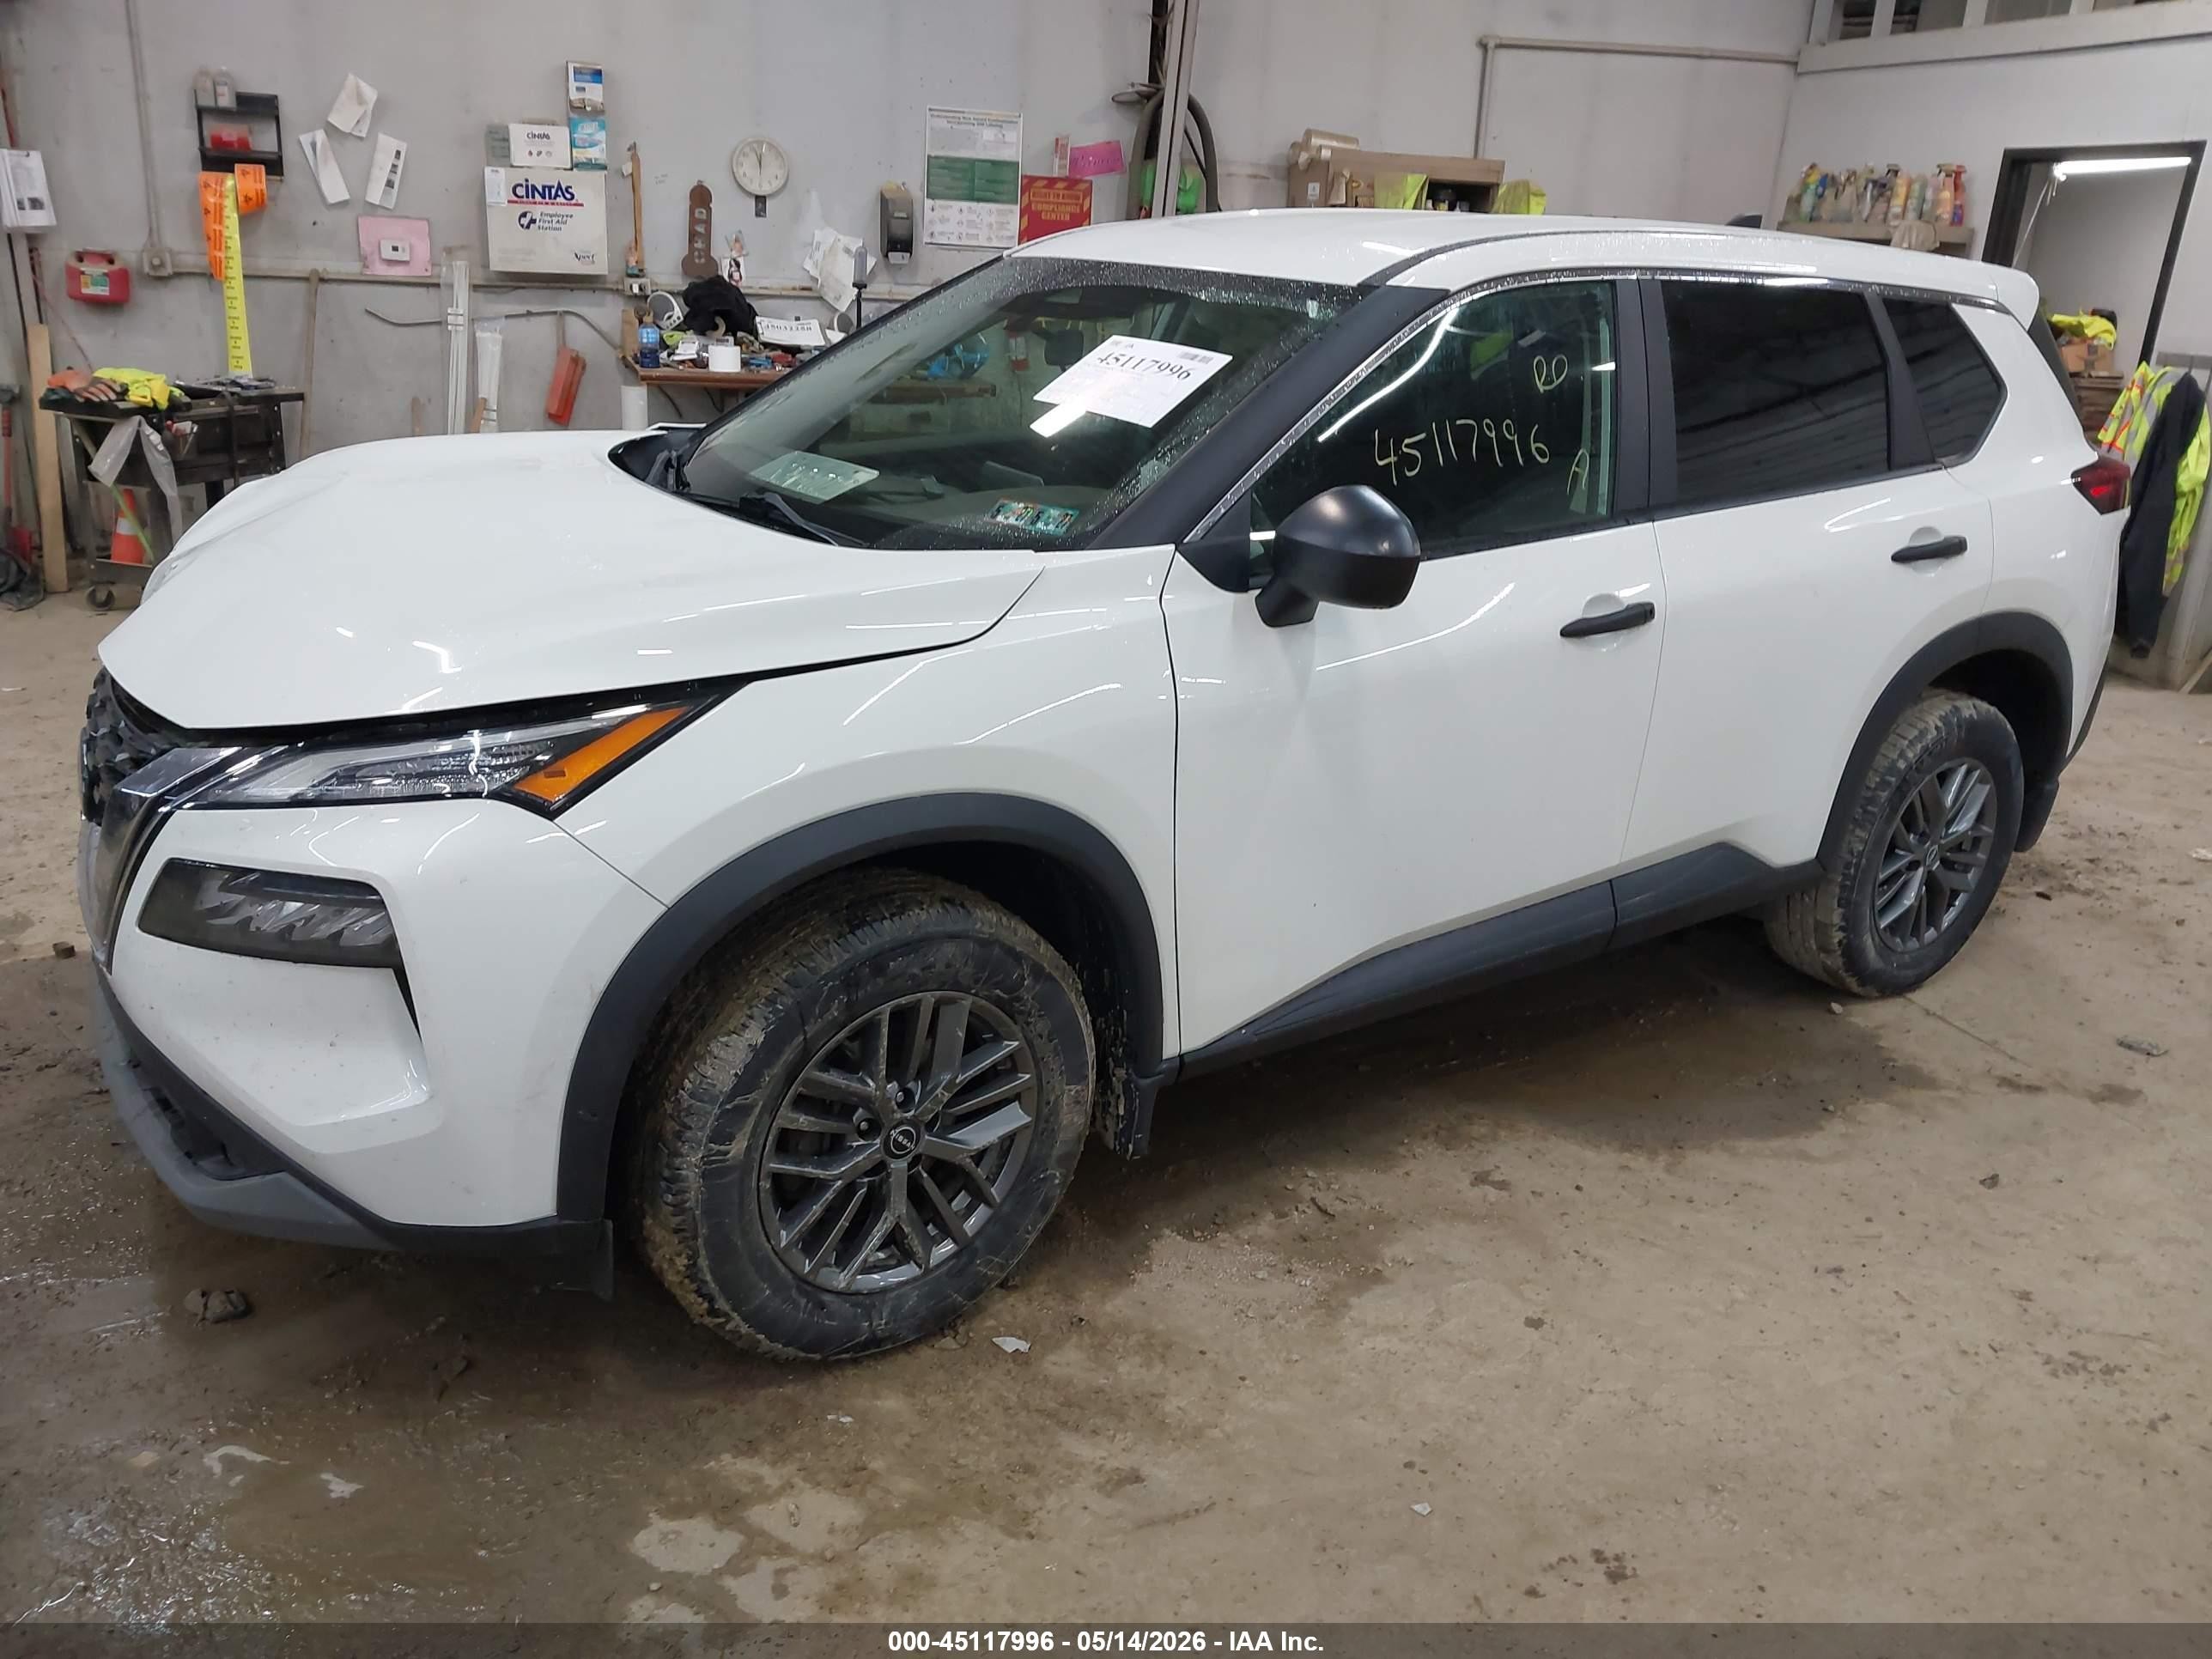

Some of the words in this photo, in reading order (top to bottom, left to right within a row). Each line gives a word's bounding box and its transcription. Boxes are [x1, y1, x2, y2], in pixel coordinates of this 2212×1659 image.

[539, 211, 574, 220] Employee
[1031, 202, 1081, 214] COMPLIANCE
[1041, 211, 1071, 221] CENTER
[1097, 350, 1192, 381] 45117996
[1374, 418, 1550, 486] 45117996
[890, 1129, 915, 1150] NISSAN
